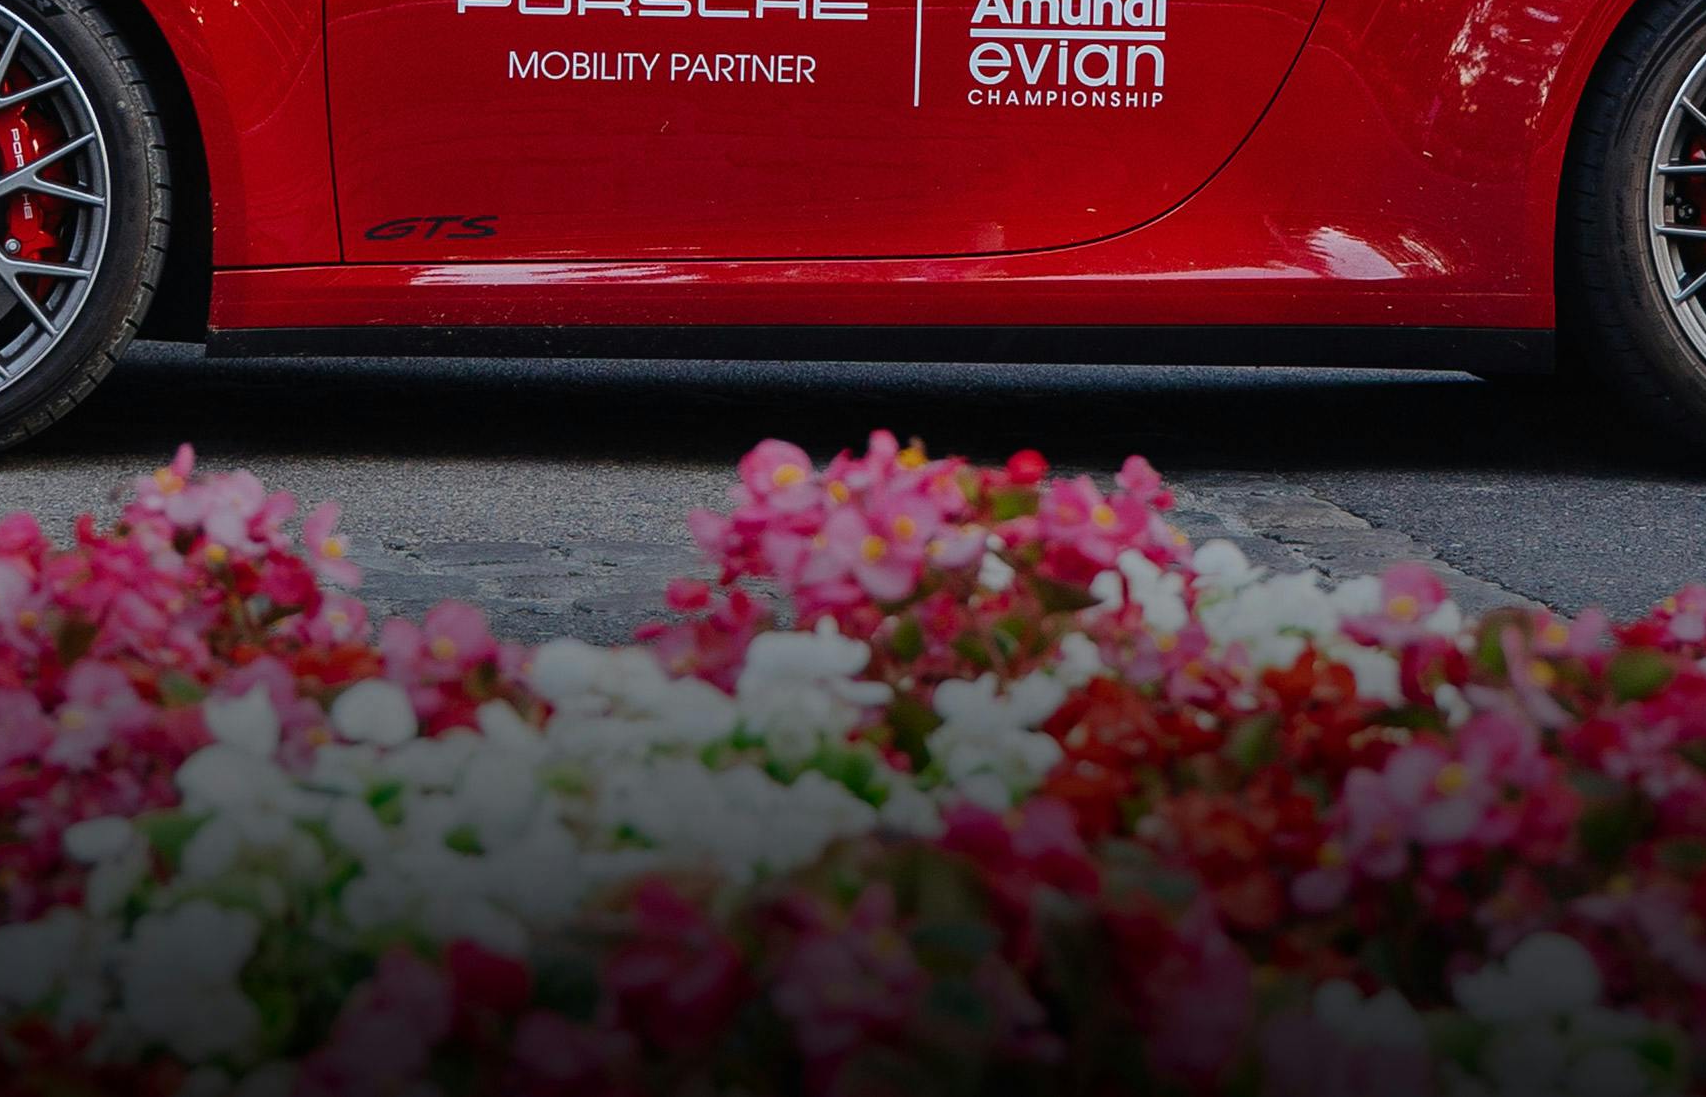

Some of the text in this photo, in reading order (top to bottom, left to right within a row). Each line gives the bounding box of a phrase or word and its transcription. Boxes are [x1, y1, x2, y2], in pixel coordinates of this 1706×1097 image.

[507, 50, 816, 84] MOBILITY PARTNER
[968, 39, 1165, 87] evian
[967, 88, 1165, 109] CHAMPIONSHIP
[364, 215, 497, 241] GTS
